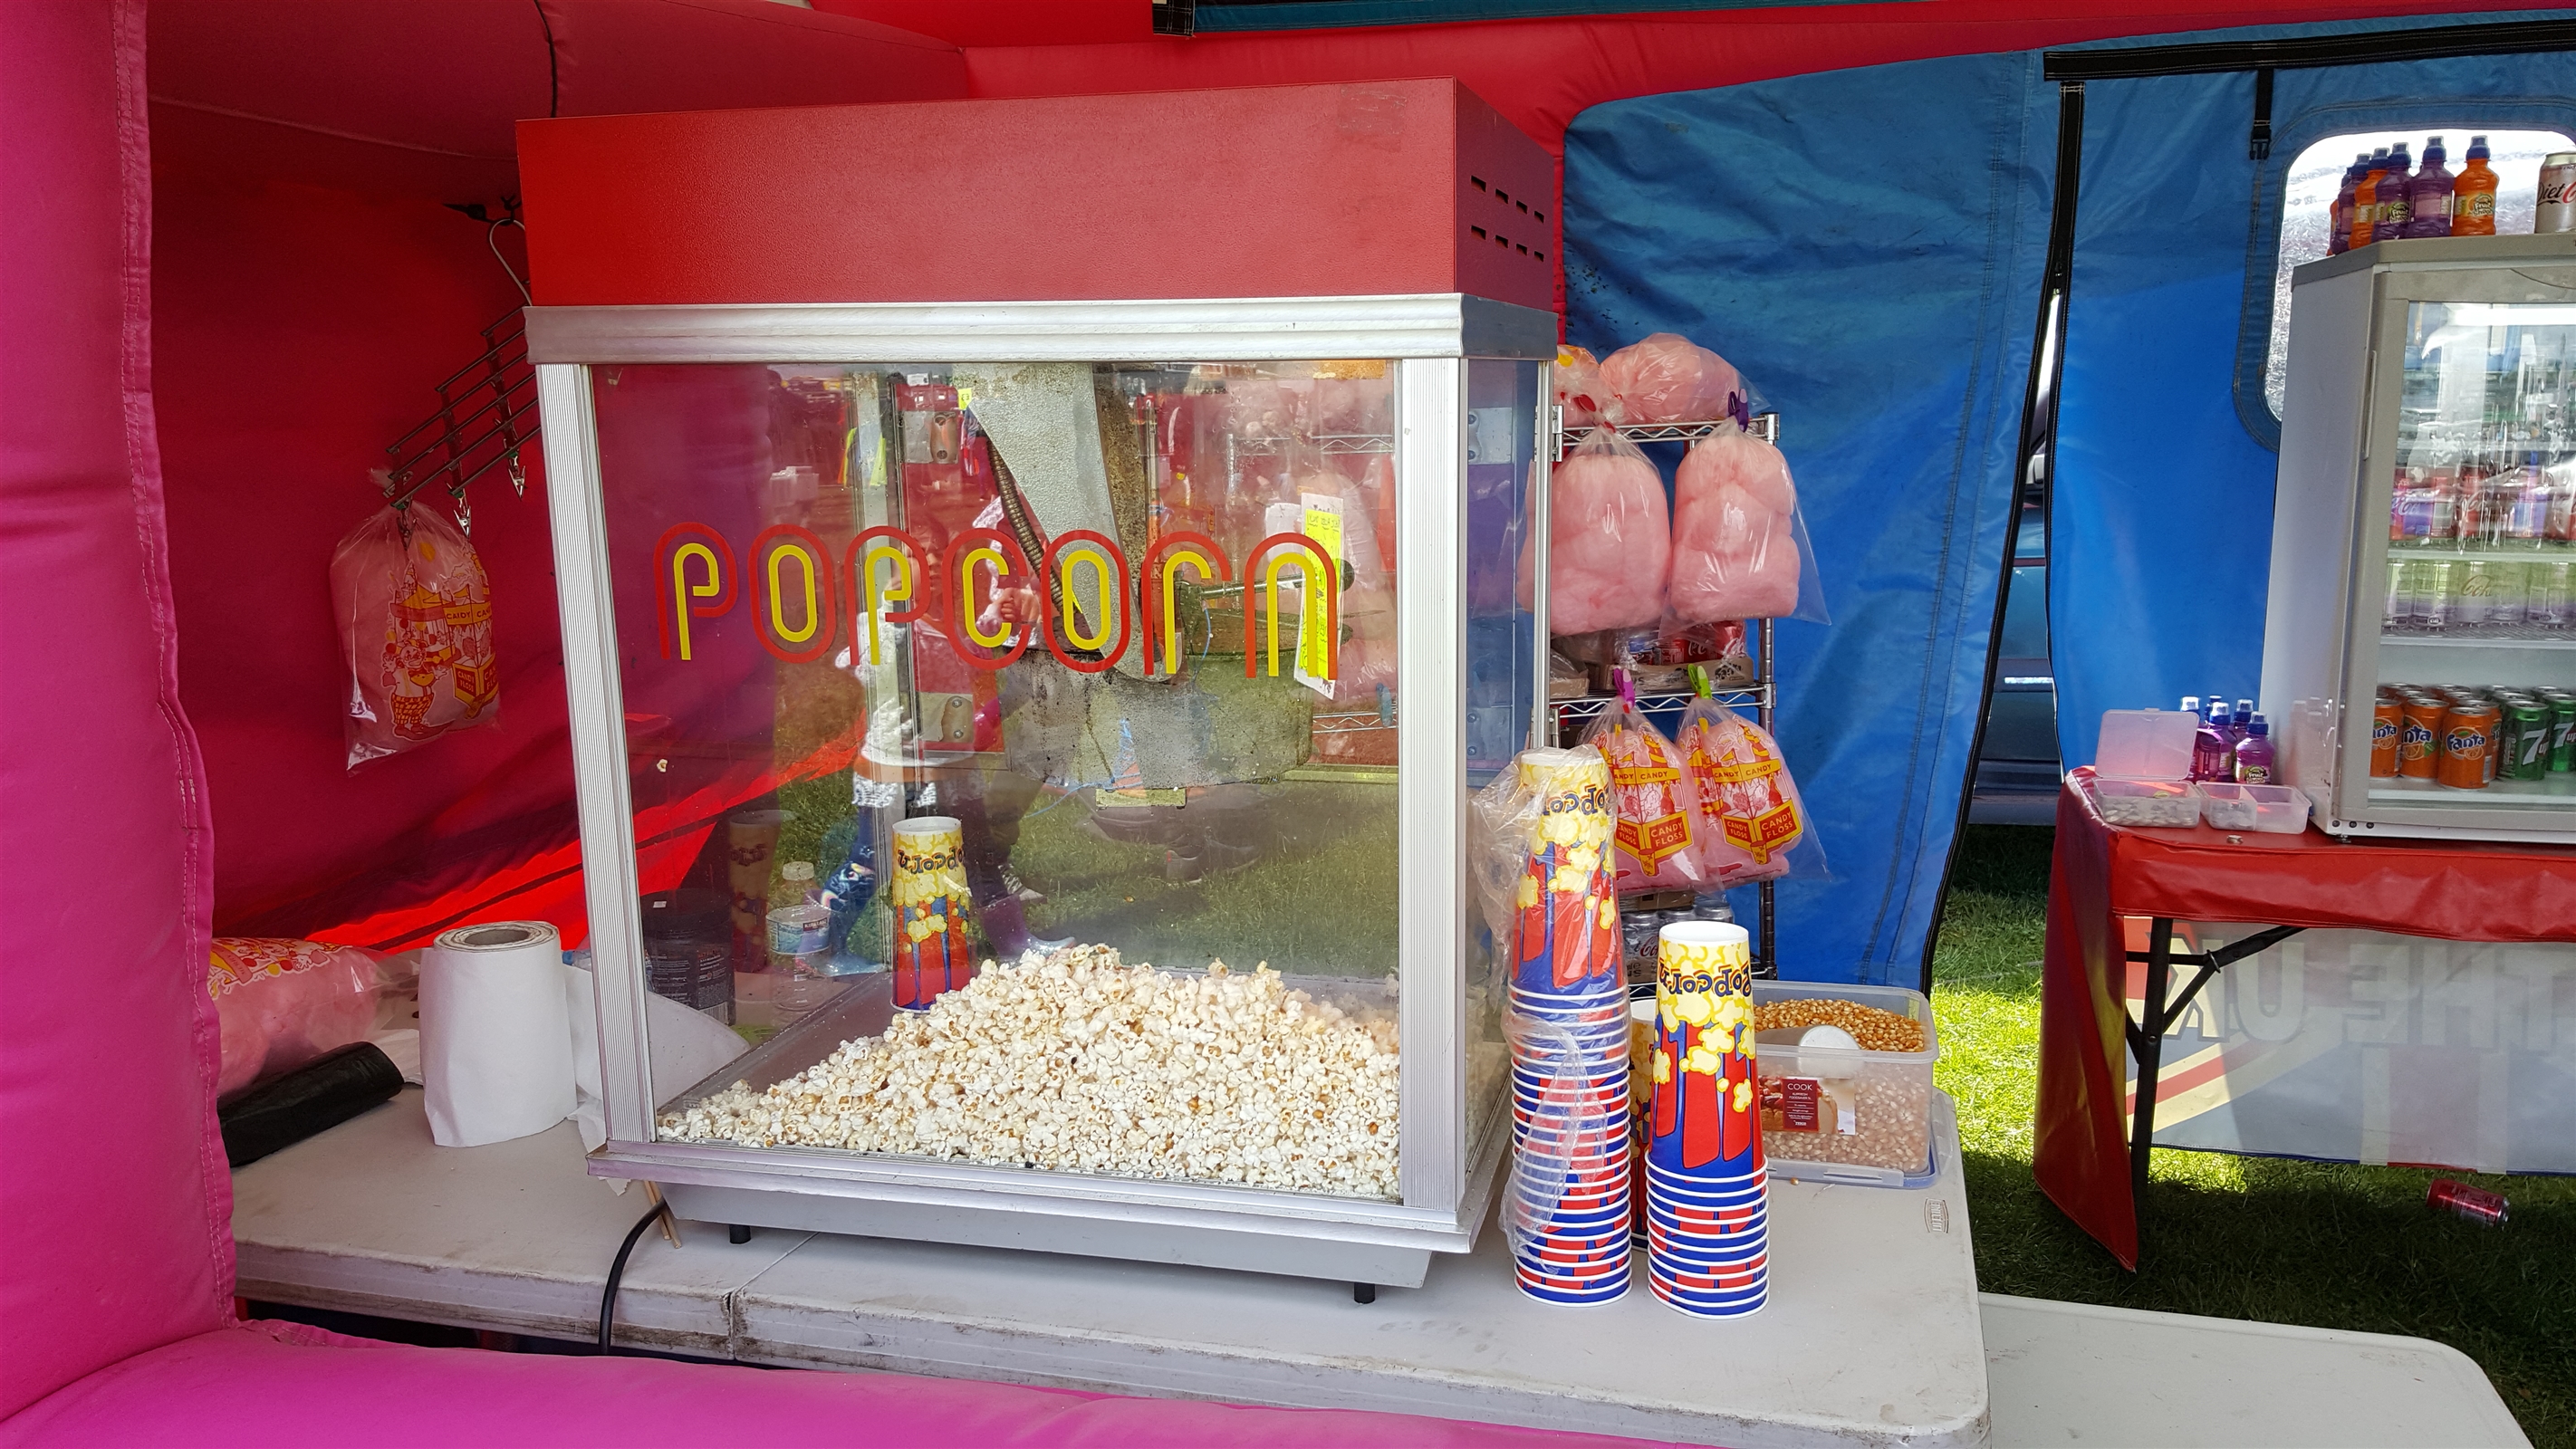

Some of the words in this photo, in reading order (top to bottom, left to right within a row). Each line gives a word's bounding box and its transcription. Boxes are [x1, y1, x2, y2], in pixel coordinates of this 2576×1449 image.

[2446, 733, 2485, 751] Fanta
[2522, 728, 2547, 765] 7
[1640, 772, 1668, 780] CANDY
[1745, 763, 1772, 776] CANDY
[1727, 821, 1748, 832] CANDY
[1761, 811, 1792, 830] CANDY
[1618, 824, 1637, 836] CANDY
[1650, 821, 1683, 838] CANDY
[1730, 829, 1748, 840] FLOSS
[1766, 820, 1793, 839] FLOSS
[1619, 832, 1637, 845] FLOSS
[1655, 831, 1683, 847] FLOSS
[1787, 1082, 1812, 1091] COOK
